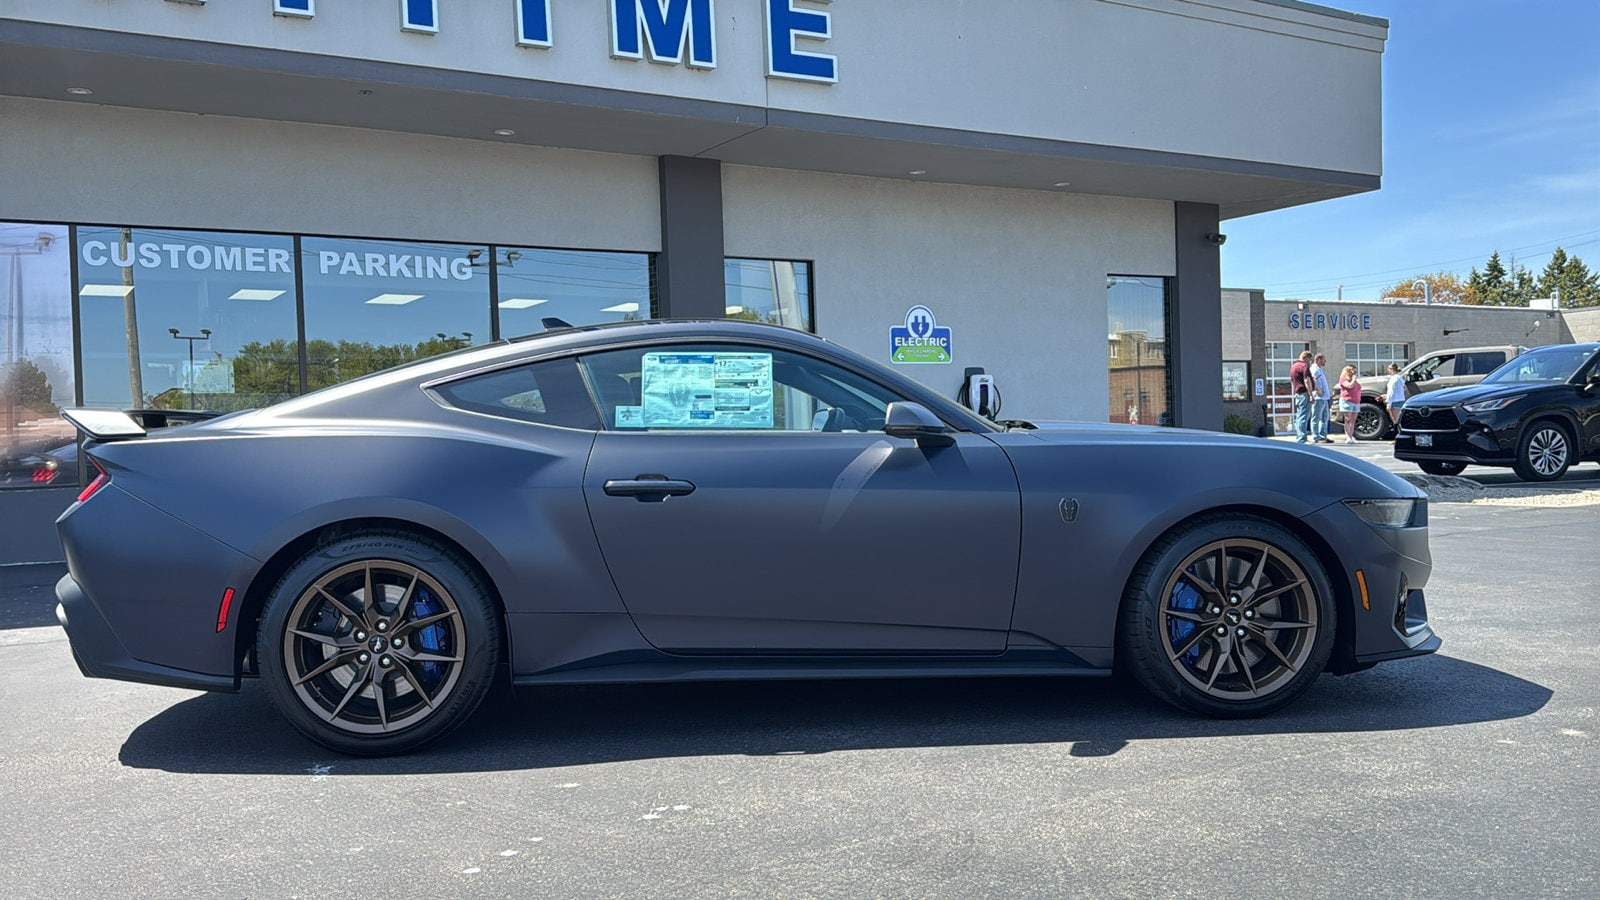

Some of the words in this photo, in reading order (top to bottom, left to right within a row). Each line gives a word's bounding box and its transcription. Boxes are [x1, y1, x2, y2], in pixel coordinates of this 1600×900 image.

[82, 240, 292, 273] CUSTOMER
[319, 251, 474, 281] PARKING
[1289, 312, 1371, 330] SERVICE
[895, 337, 947, 347] ELECTRIC
